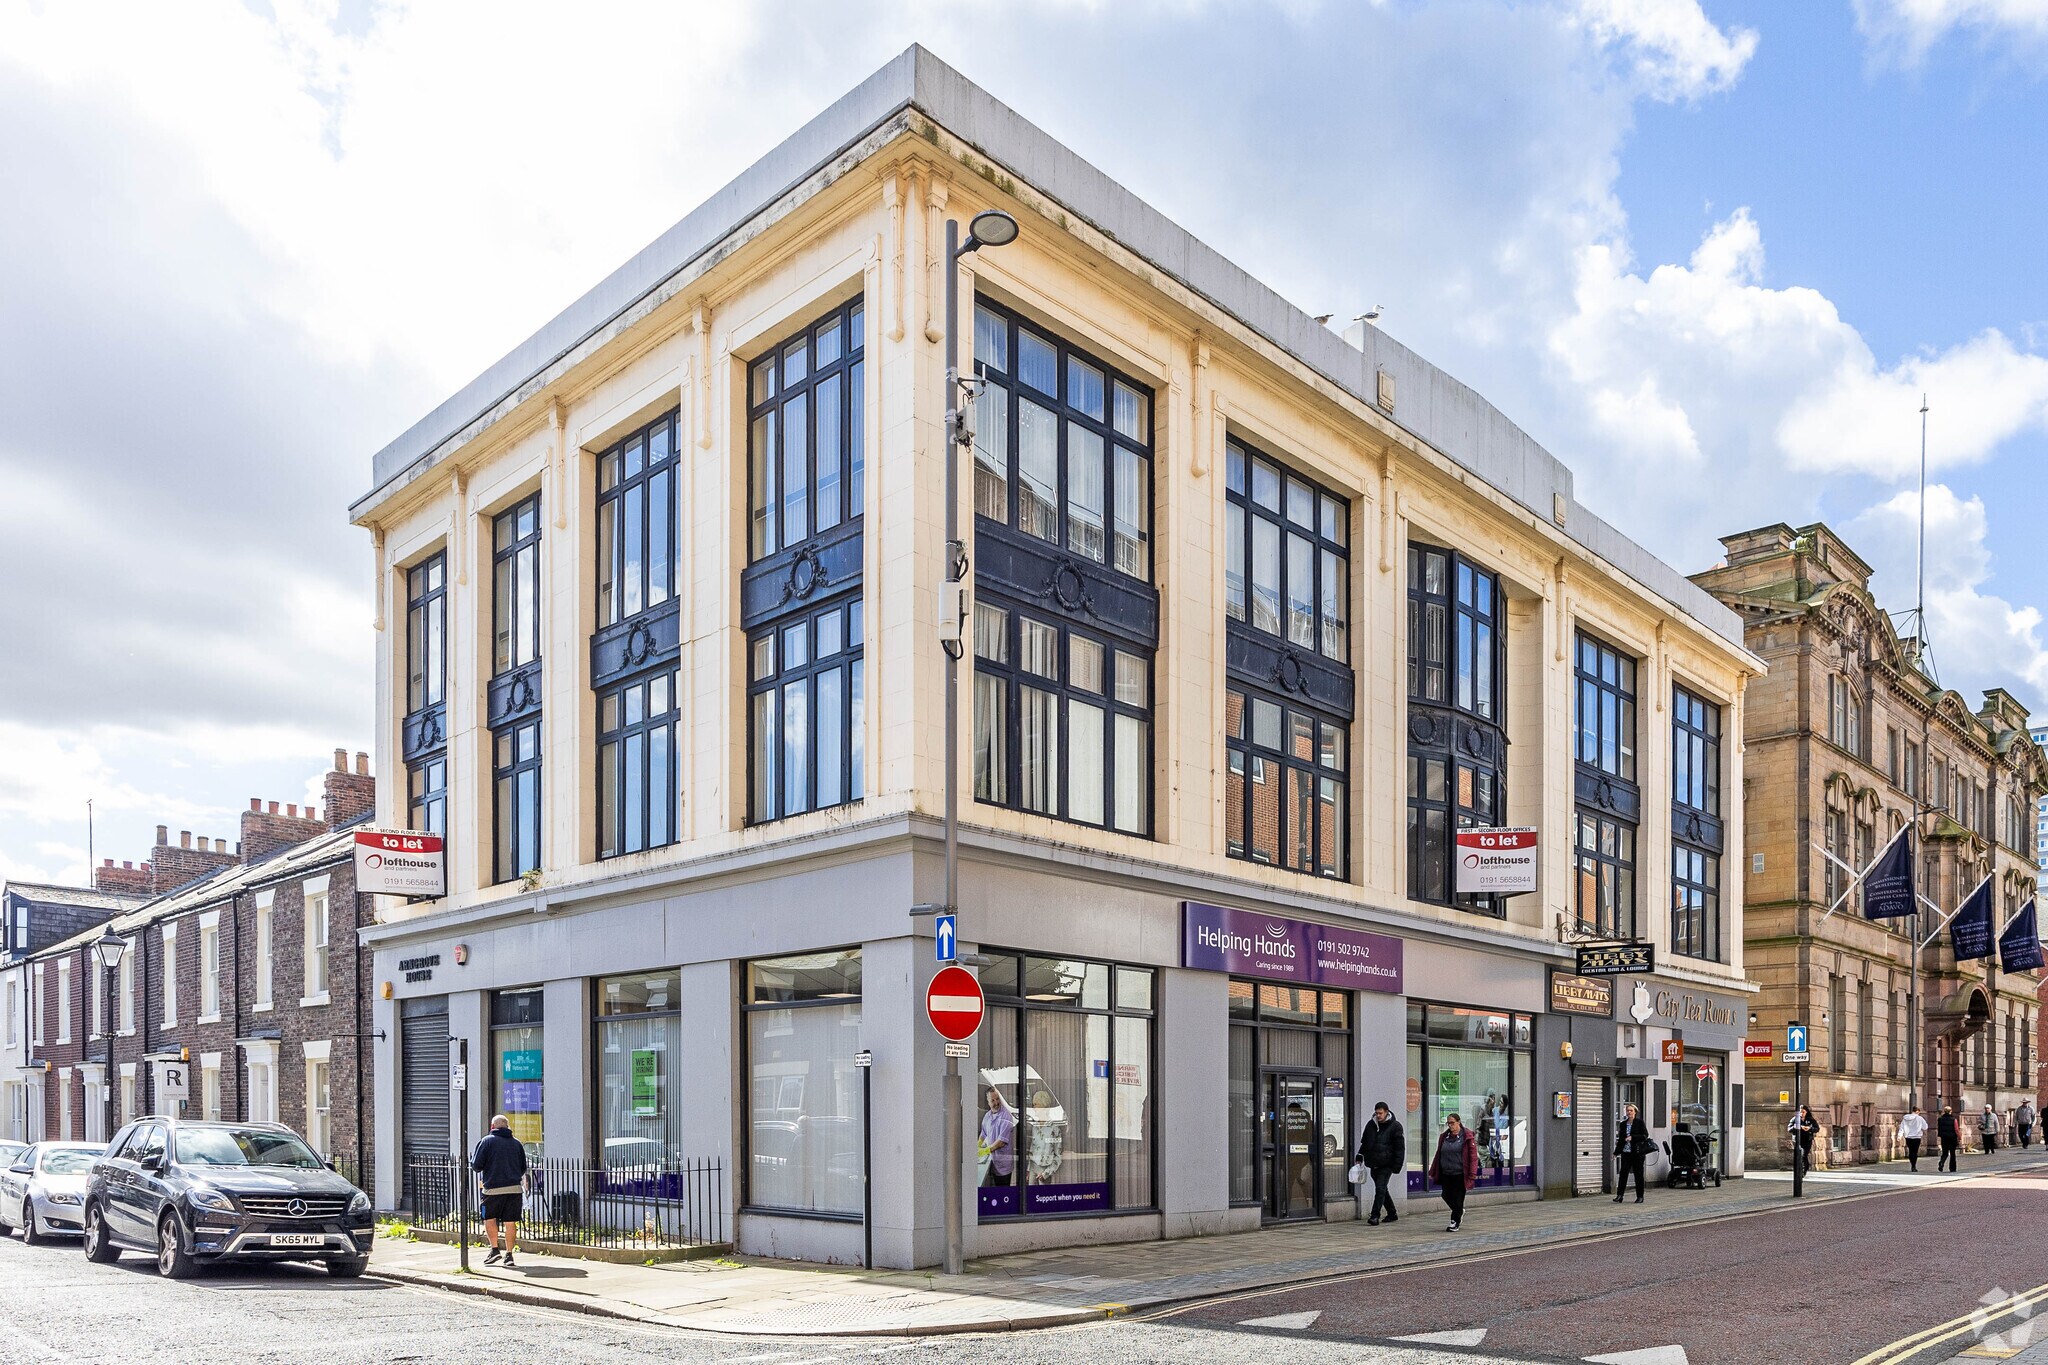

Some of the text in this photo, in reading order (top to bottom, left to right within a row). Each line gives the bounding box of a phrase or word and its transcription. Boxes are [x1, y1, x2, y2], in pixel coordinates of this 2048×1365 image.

[382, 837, 423, 849] to let
[1480, 835, 1518, 846] to let
[384, 857, 436, 868] lofthouse
[1481, 856, 1530, 864] lofthouse
[1875, 881, 1902, 889] BUILDING
[1870, 889, 1902, 897] CONFERENCE
[1199, 925, 1296, 958] Helping Hands
[1318, 940, 1369, 958] 0191 502 9742
[398, 955, 440, 971] ARNGROVE
[1256, 960, 1294, 972] Caring since 1989
[1318, 959, 1397, 977] www.helpinghands.co.uk
[406, 969, 432, 983] HOUSE
[1554, 985, 1610, 1001] LIBBY MAYS
[1656, 991, 1680, 1025] City
[1683, 995, 1701, 1021] Tea
[636, 1057, 653, 1066] WE'RE
[1036, 1195, 1057, 1203] Support
[1073, 1194, 1082, 1202] you
[276, 1236, 320, 1244] SK65 MYL
